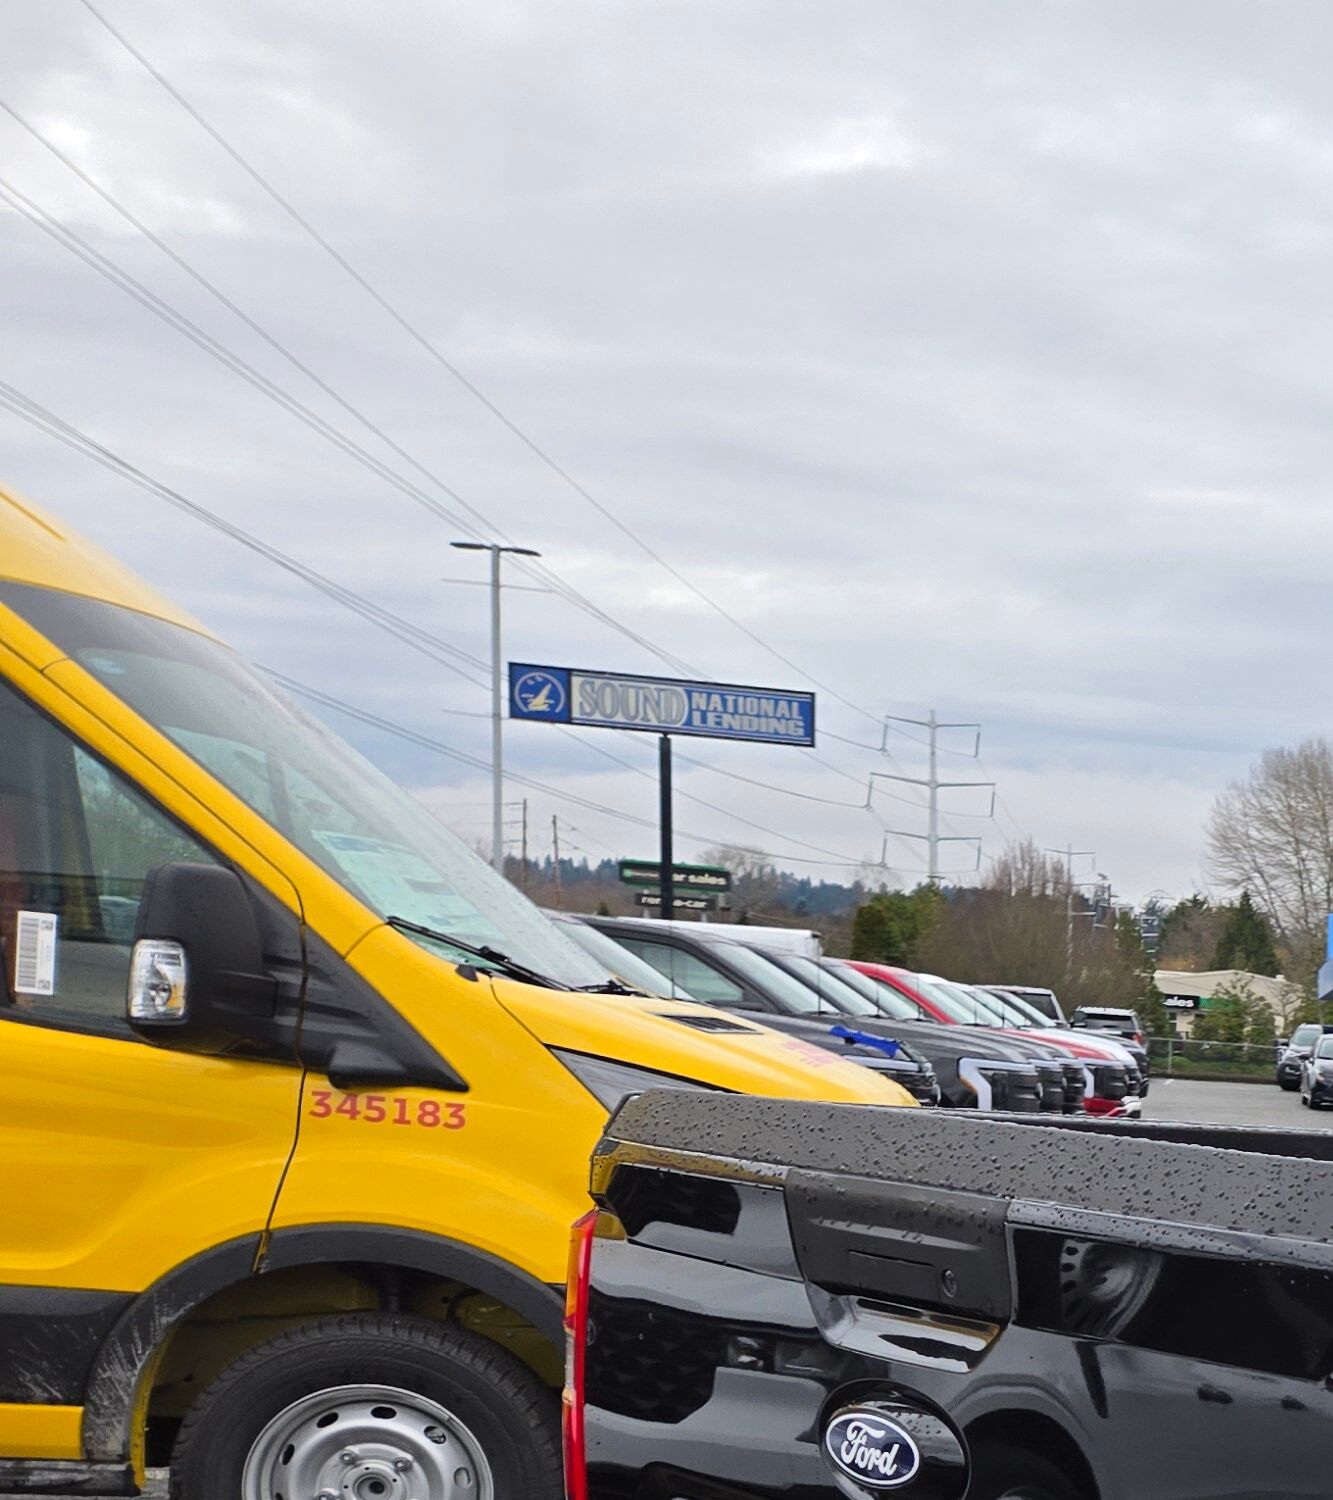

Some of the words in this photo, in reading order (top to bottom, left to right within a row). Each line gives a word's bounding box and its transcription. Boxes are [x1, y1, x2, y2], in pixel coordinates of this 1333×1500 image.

[578, 679, 685, 725] SOUND
[692, 692, 803, 719] NATIONAL
[692, 711, 804, 736] LENDING
[309, 1090, 466, 1129] 345183
[841, 1421, 899, 1475] Ford
